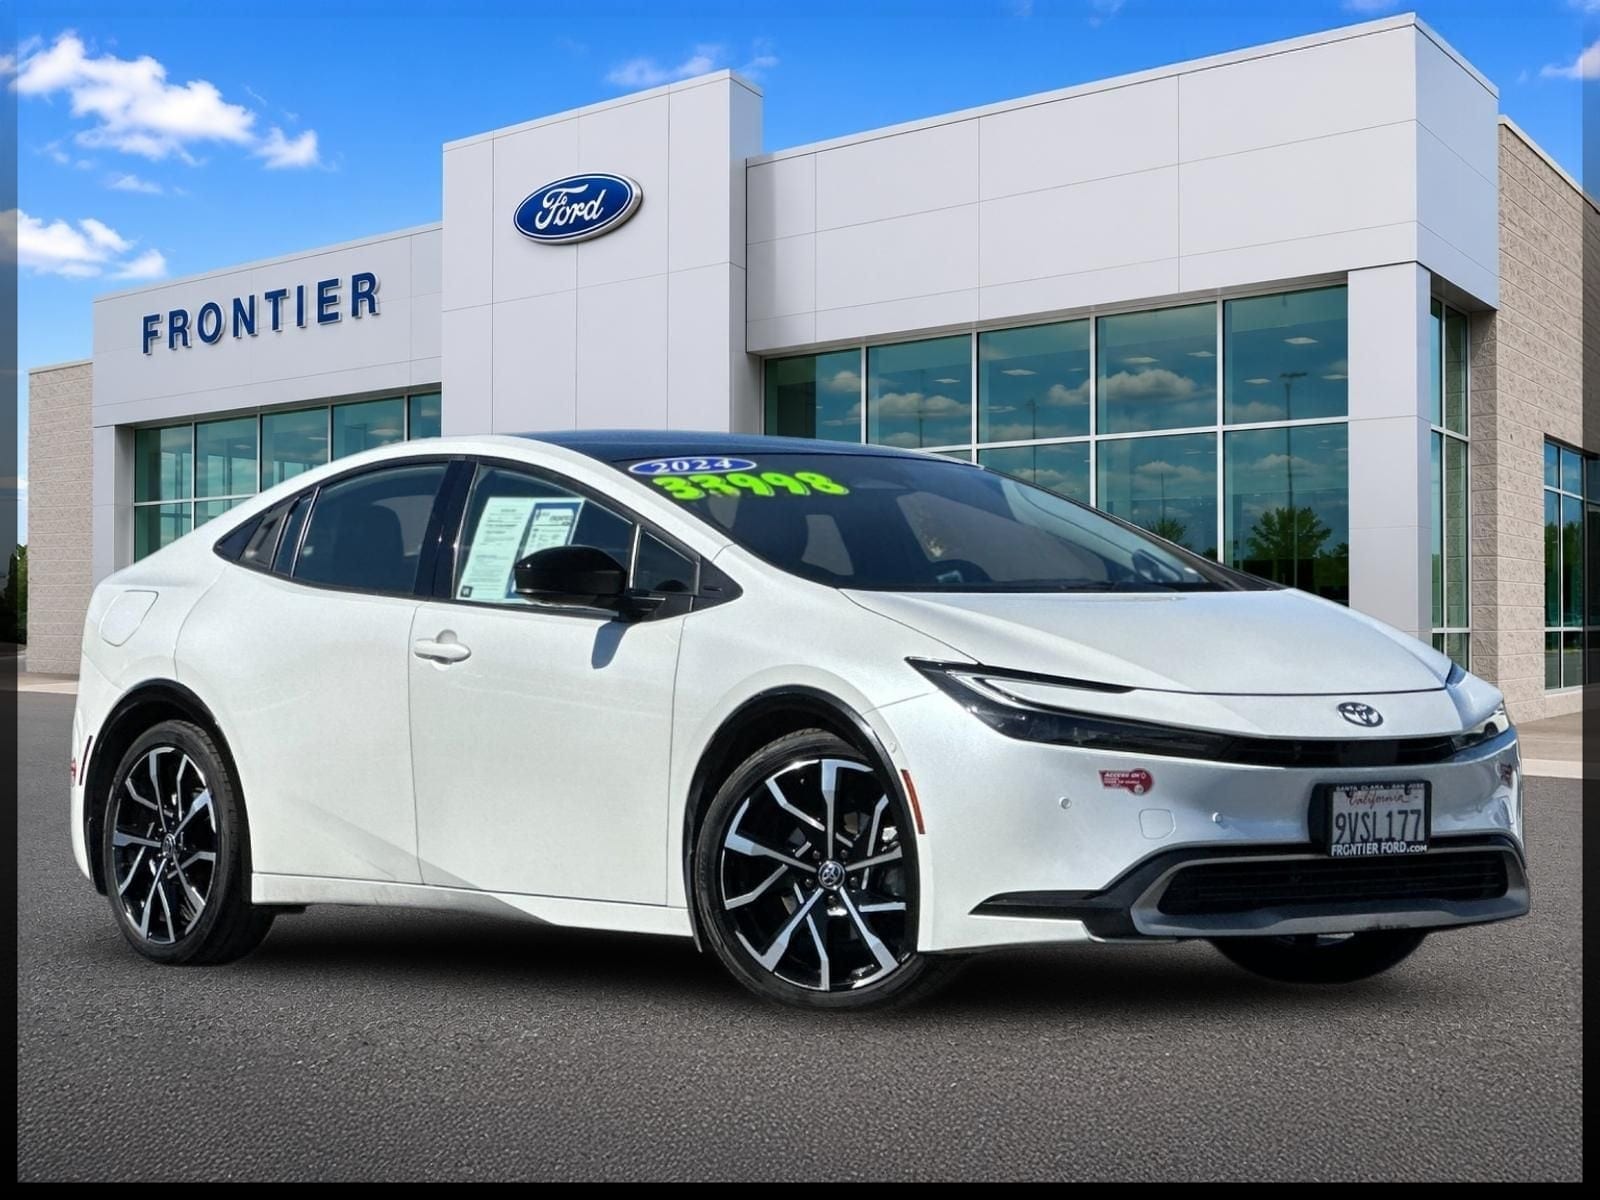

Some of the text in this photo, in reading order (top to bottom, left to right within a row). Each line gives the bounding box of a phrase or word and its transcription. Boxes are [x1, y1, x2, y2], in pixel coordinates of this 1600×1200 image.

[535, 183, 607, 230] Ford
[142, 271, 381, 356] FRONTIER
[650, 458, 733, 474] 2024
[652, 471, 850, 500] 33998
[1347, 789, 1410, 809] California
[1335, 809, 1421, 843] 9VSL177
[1331, 843, 1379, 856] FRONTIER
